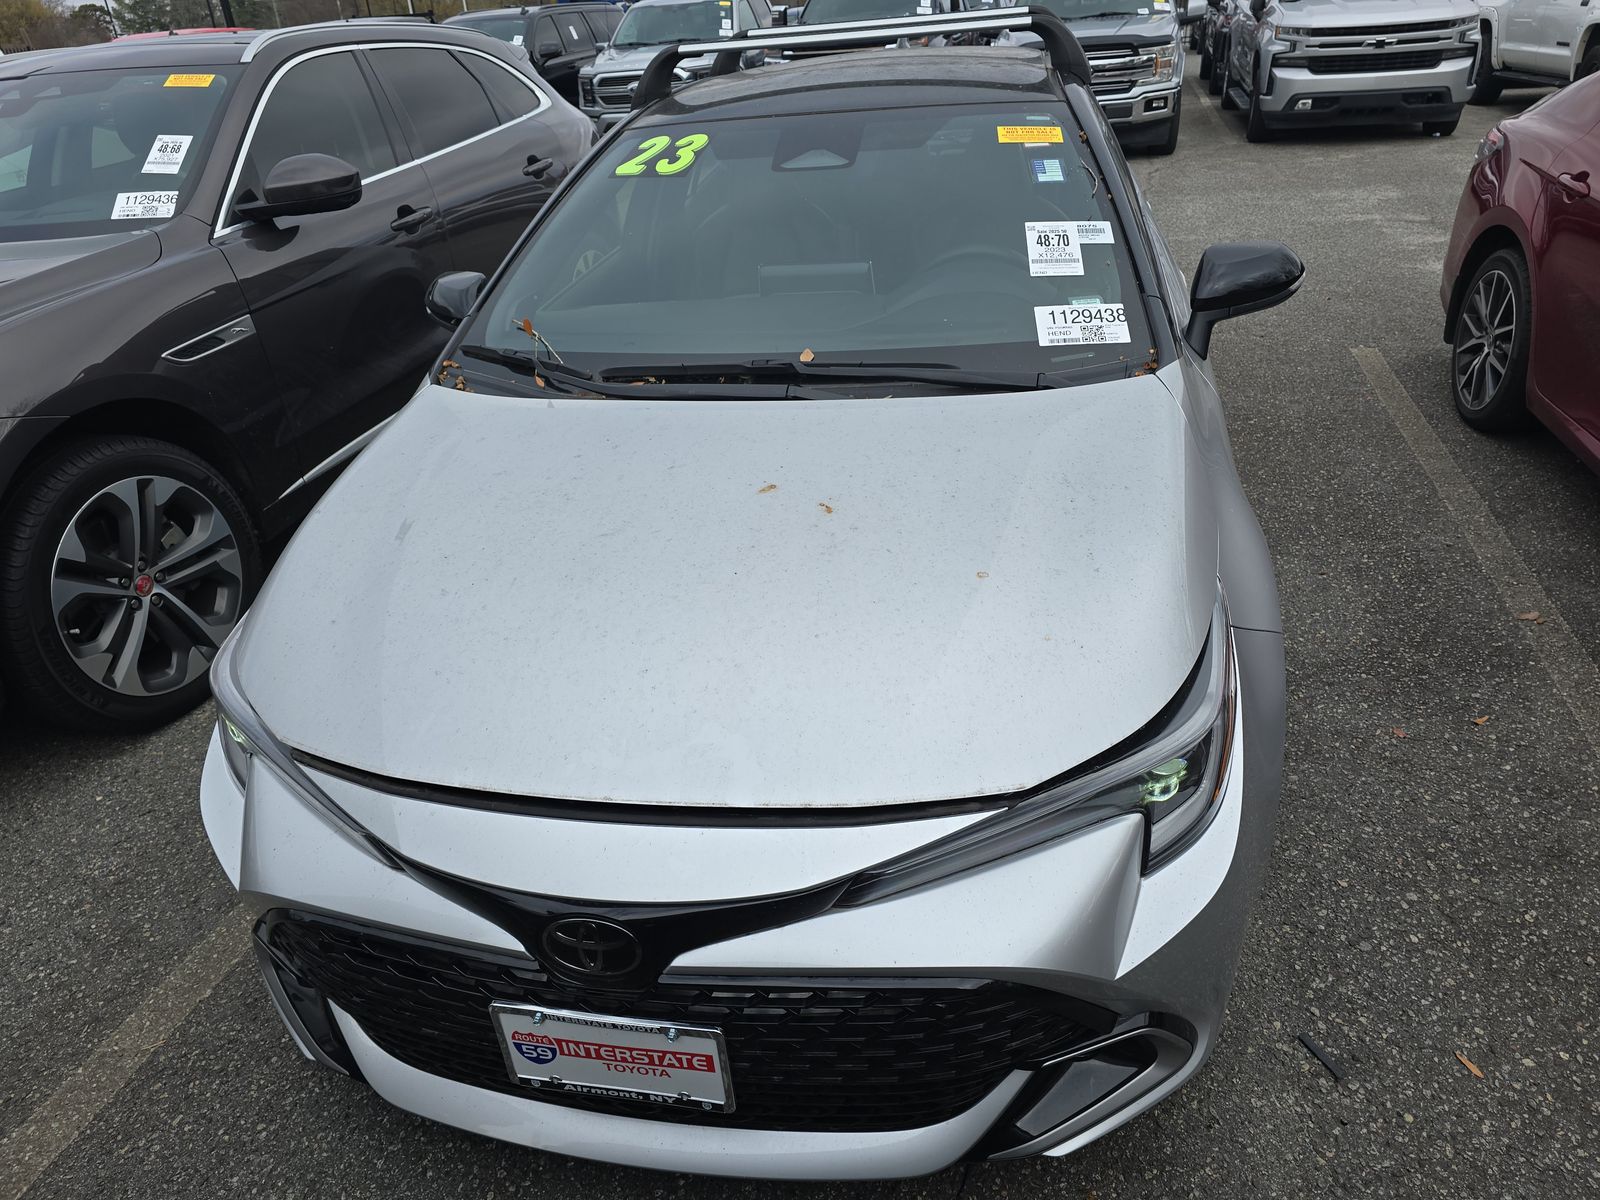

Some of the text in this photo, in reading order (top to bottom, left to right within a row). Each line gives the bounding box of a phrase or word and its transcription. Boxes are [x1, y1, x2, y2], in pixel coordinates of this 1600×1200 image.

[157, 144, 182, 154] 48:68
[615, 133, 709, 176] 23
[125, 193, 179, 206] 1129436
[1036, 233, 1070, 247] 48:70
[1048, 307, 1126, 325] 1129438
[546, 1014, 660, 1034] INTERSTATE TOYOTA
[514, 1033, 549, 1045] ROUTE
[521, 1045, 553, 1060] 59
[562, 1041, 708, 1070] INTERSTATE
[602, 1062, 671, 1078] TOYOTA
[563, 1084, 677, 1104] Airmont, NY
